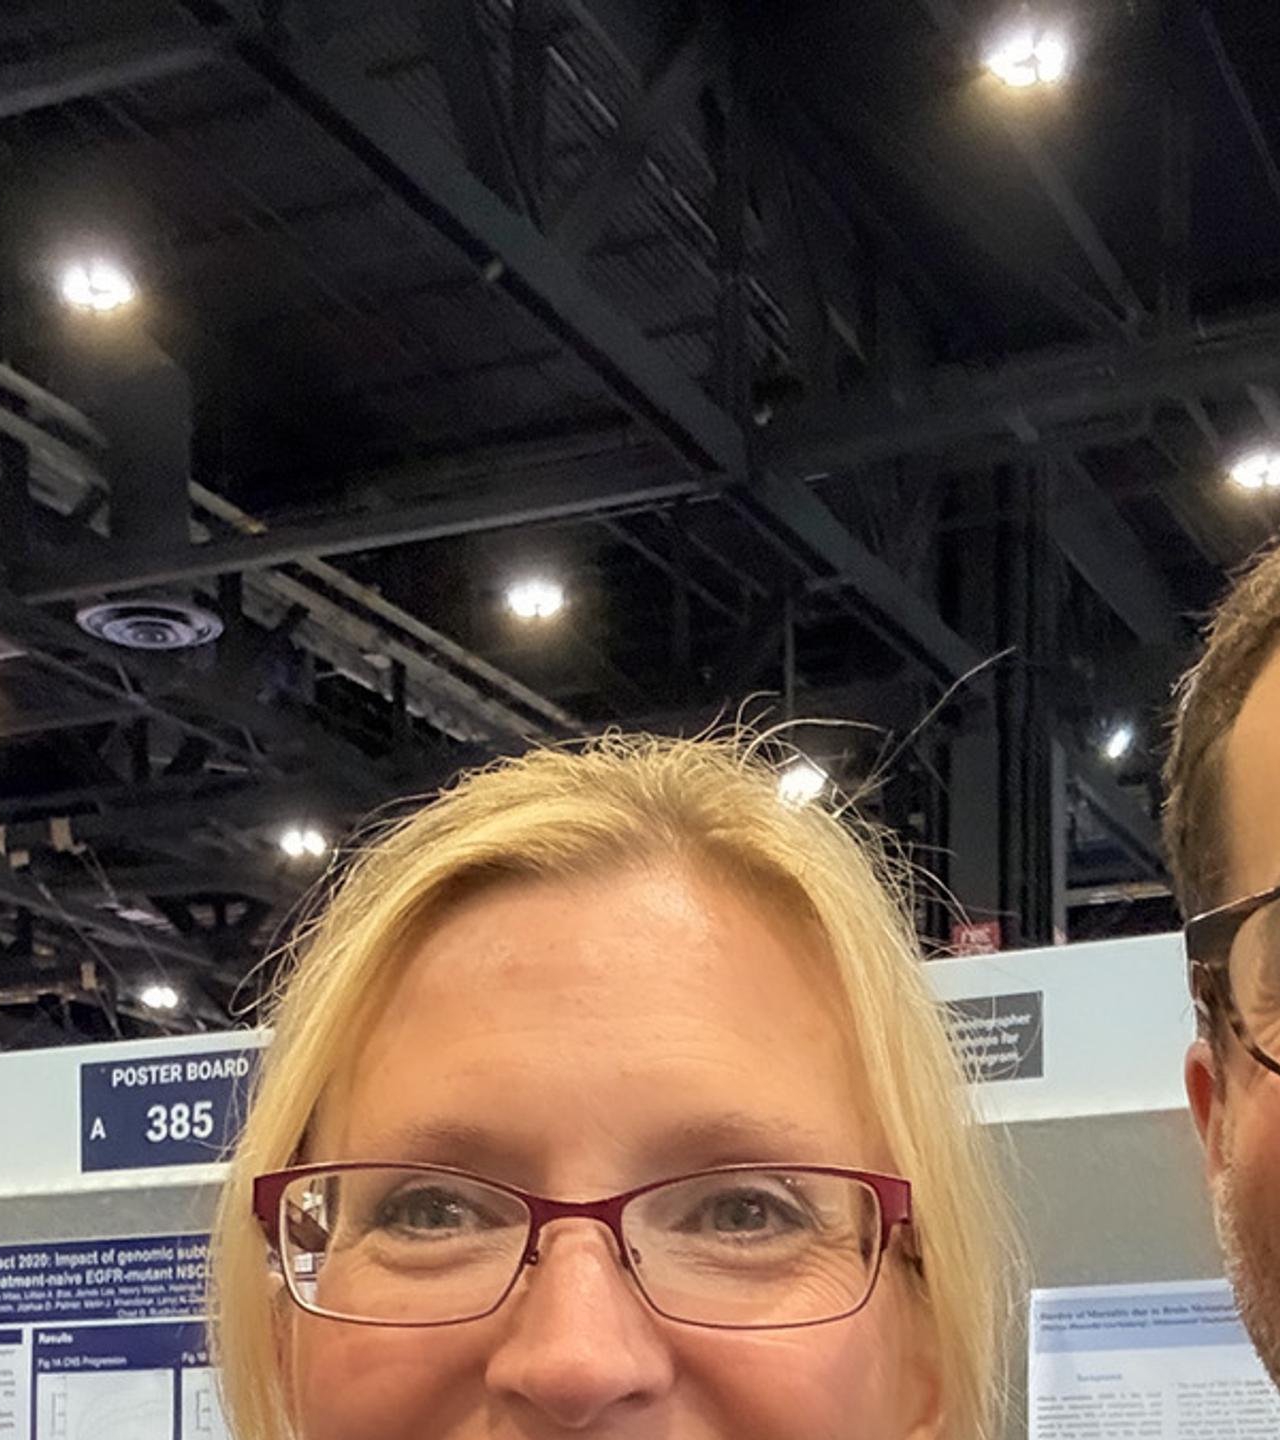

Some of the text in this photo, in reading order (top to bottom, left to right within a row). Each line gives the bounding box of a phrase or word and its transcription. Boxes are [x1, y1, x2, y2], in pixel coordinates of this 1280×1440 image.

[111, 1057, 249, 1088] POSTER BOARD
[89, 1101, 214, 1142] A 385
[55, 1250, 98, 1270] Impact
[101, 1248, 115, 1265] of
[117, 1245, 174, 1267] genomic
[85, 1265, 174, 1285] EGFR-mutant
[38, 1332, 74, 1345] Results
